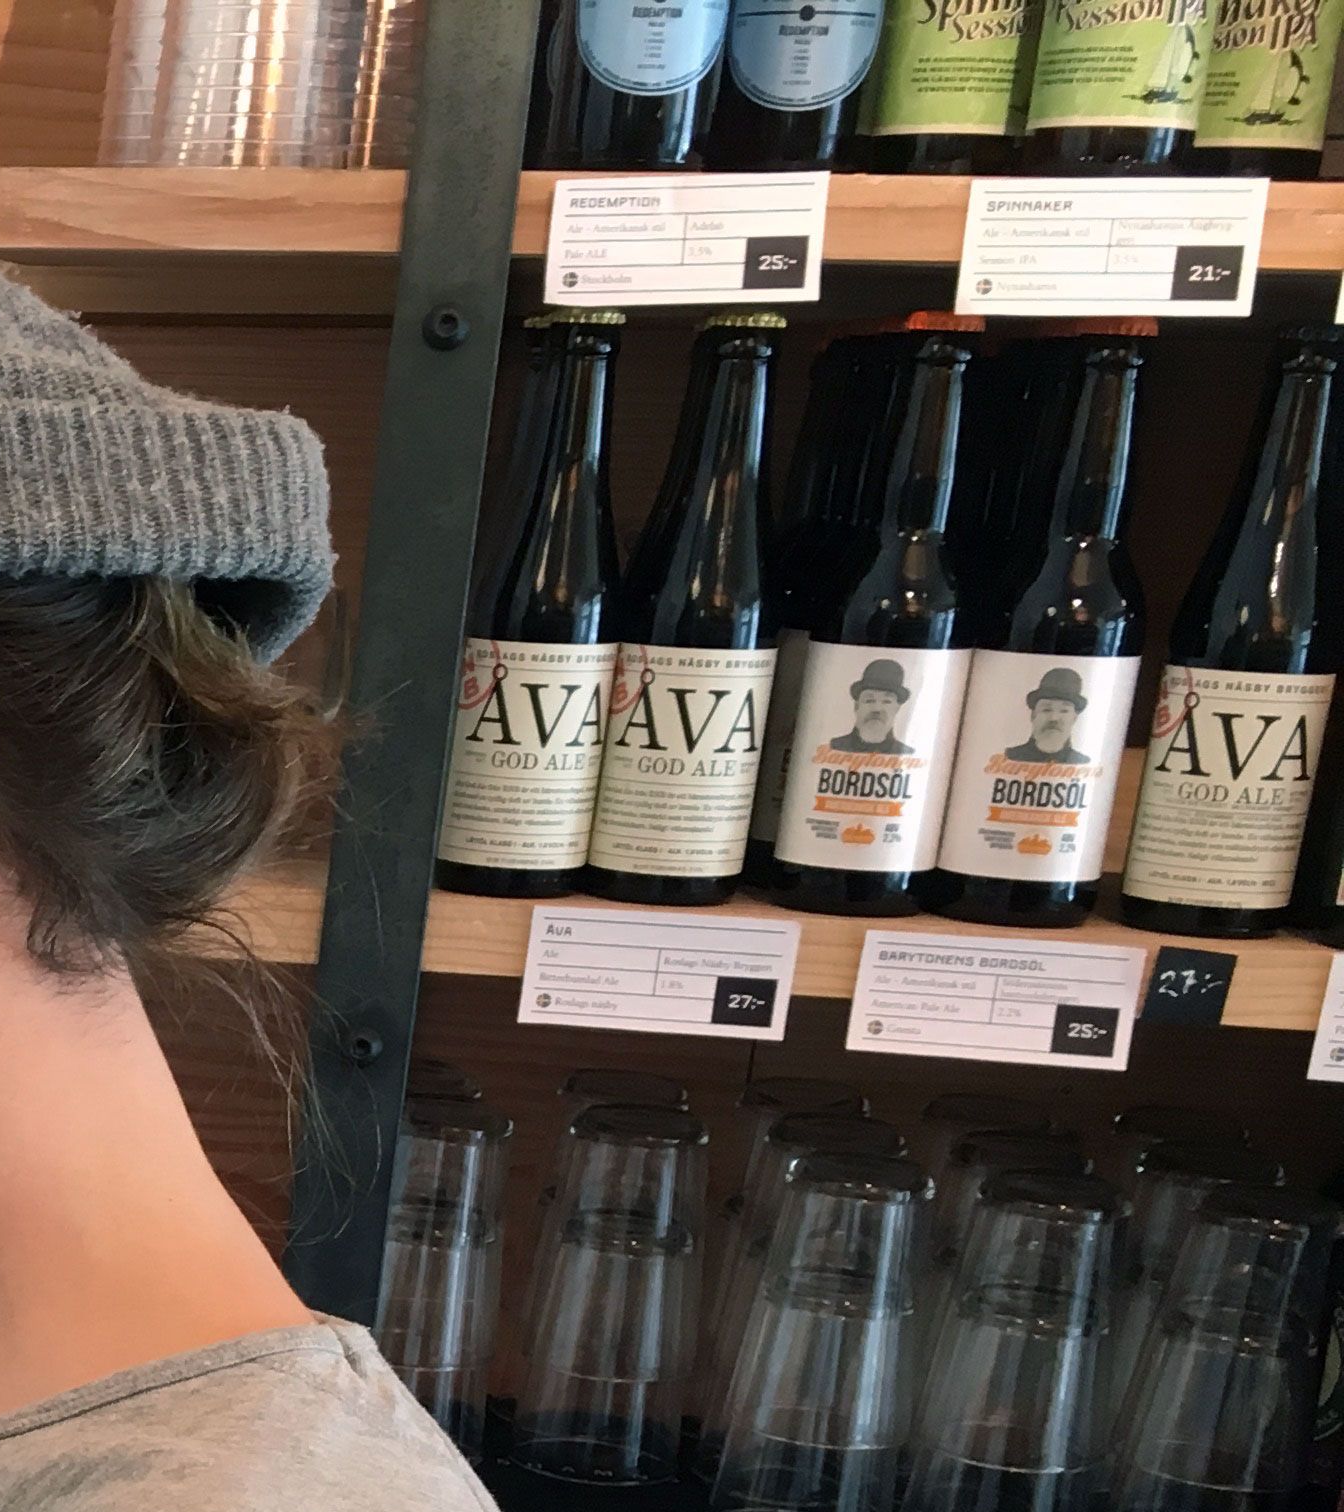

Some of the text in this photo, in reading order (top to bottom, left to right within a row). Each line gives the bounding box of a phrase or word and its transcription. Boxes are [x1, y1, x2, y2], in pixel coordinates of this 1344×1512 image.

[569, 196, 661, 209] REDEMPTION
[986, 200, 1074, 212] SPINNAKER
[757, 254, 798, 271] 25:-
[1187, 264, 1232, 283] 21:-
[491, 751, 587, 771] GOD ALE
[637, 756, 737, 777] GOD ALE
[817, 767, 913, 800] BORDSÖL
[991, 777, 1087, 809] BORDSÖL
[1177, 781, 1286, 806] GOD ALE
[878, 950, 975, 967] BARYTONENS
[727, 993, 766, 1011] 27:-
[1067, 1022, 1109, 1040] 25:-
